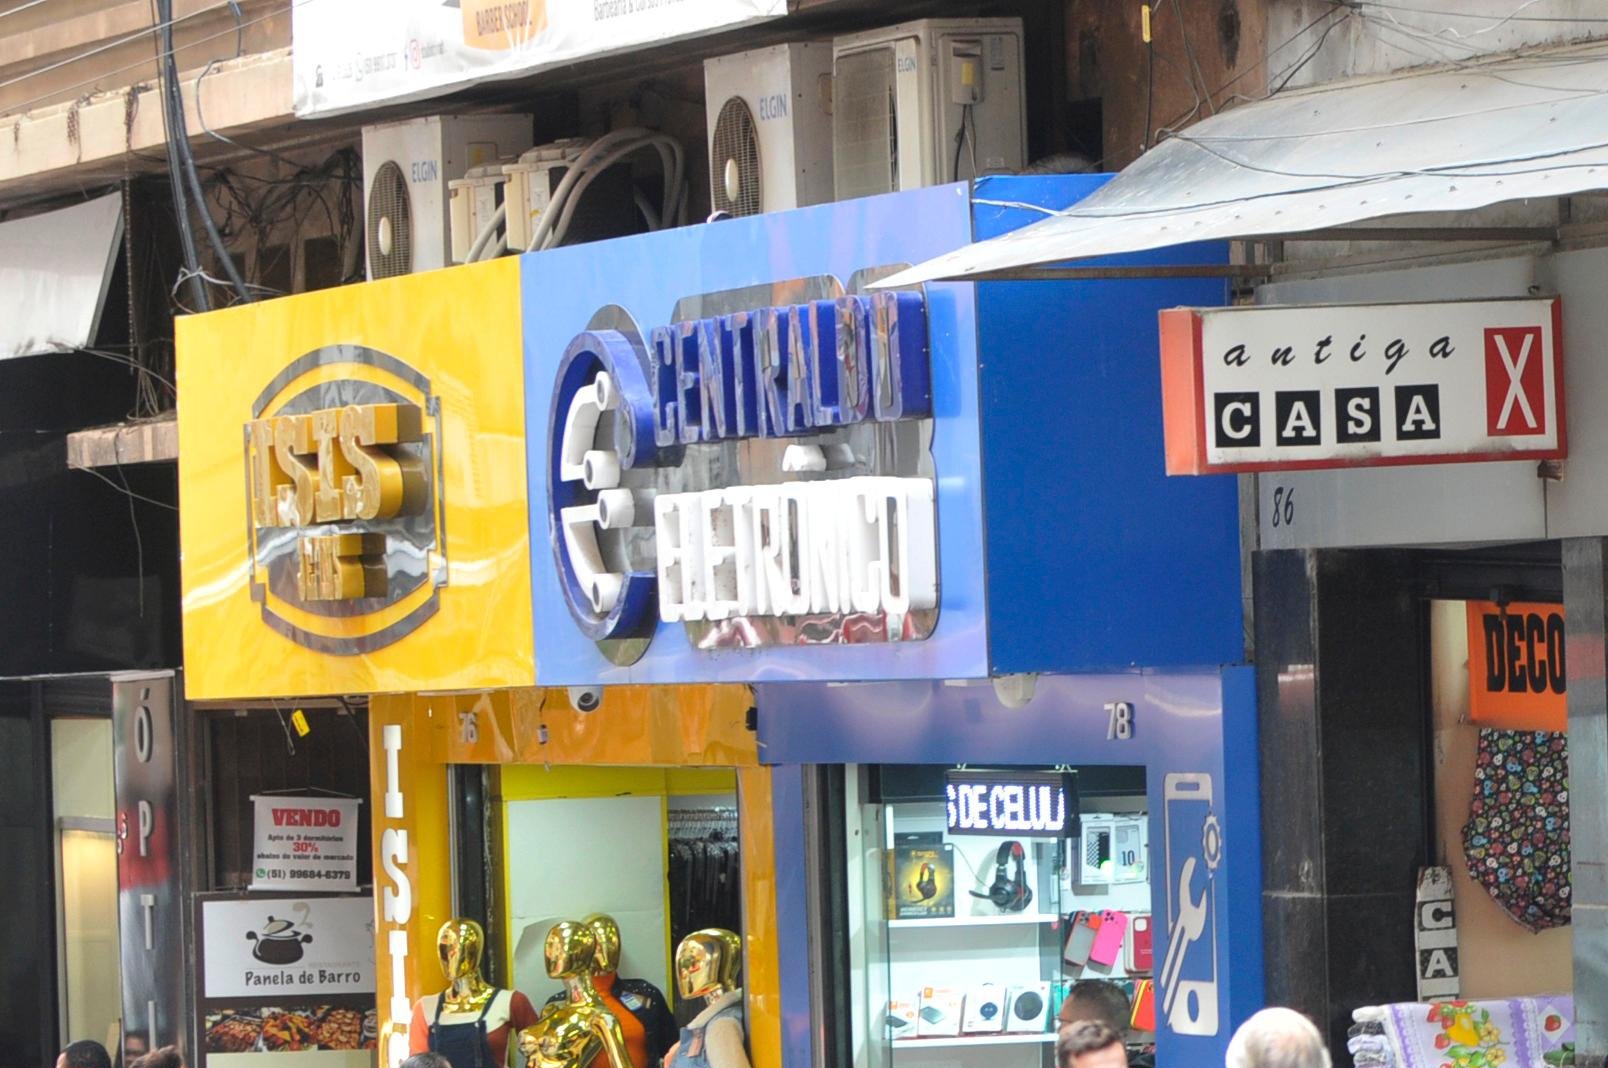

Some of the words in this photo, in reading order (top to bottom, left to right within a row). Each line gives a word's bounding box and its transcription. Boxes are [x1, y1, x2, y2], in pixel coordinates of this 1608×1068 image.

[476, 7, 503, 36] BARBER
[897, 56, 917, 73] ELGIN
[759, 94, 787, 120] ELGIN
[411, 160, 437, 184] ELGIN
[650, 300, 841, 447] CENTRAL
[836, 291, 904, 425] DO
[1223, 334, 1456, 375] antiga
[1493, 333, 1538, 429] X
[1221, 394, 1436, 440] CASA
[250, 405, 383, 528] ISIS
[1271, 486, 1295, 528] 86
[653, 444, 912, 623] ELETRÔNICO
[1483, 613, 1567, 695] DECO
[457, 711, 479, 745] 76
[1103, 701, 1134, 740] 78
[272, 808, 341, 828] VENDO
[958, 784, 988, 829] DE
[292, 842, 319, 853] 30%
[1121, 849, 1136, 867] 10
[267, 869, 287, 881] (51)
[1421, 900, 1456, 1003] CA
[244, 970, 294, 987] Panela
[298, 970, 314, 985] de
[318, 969, 361, 985] Barro
